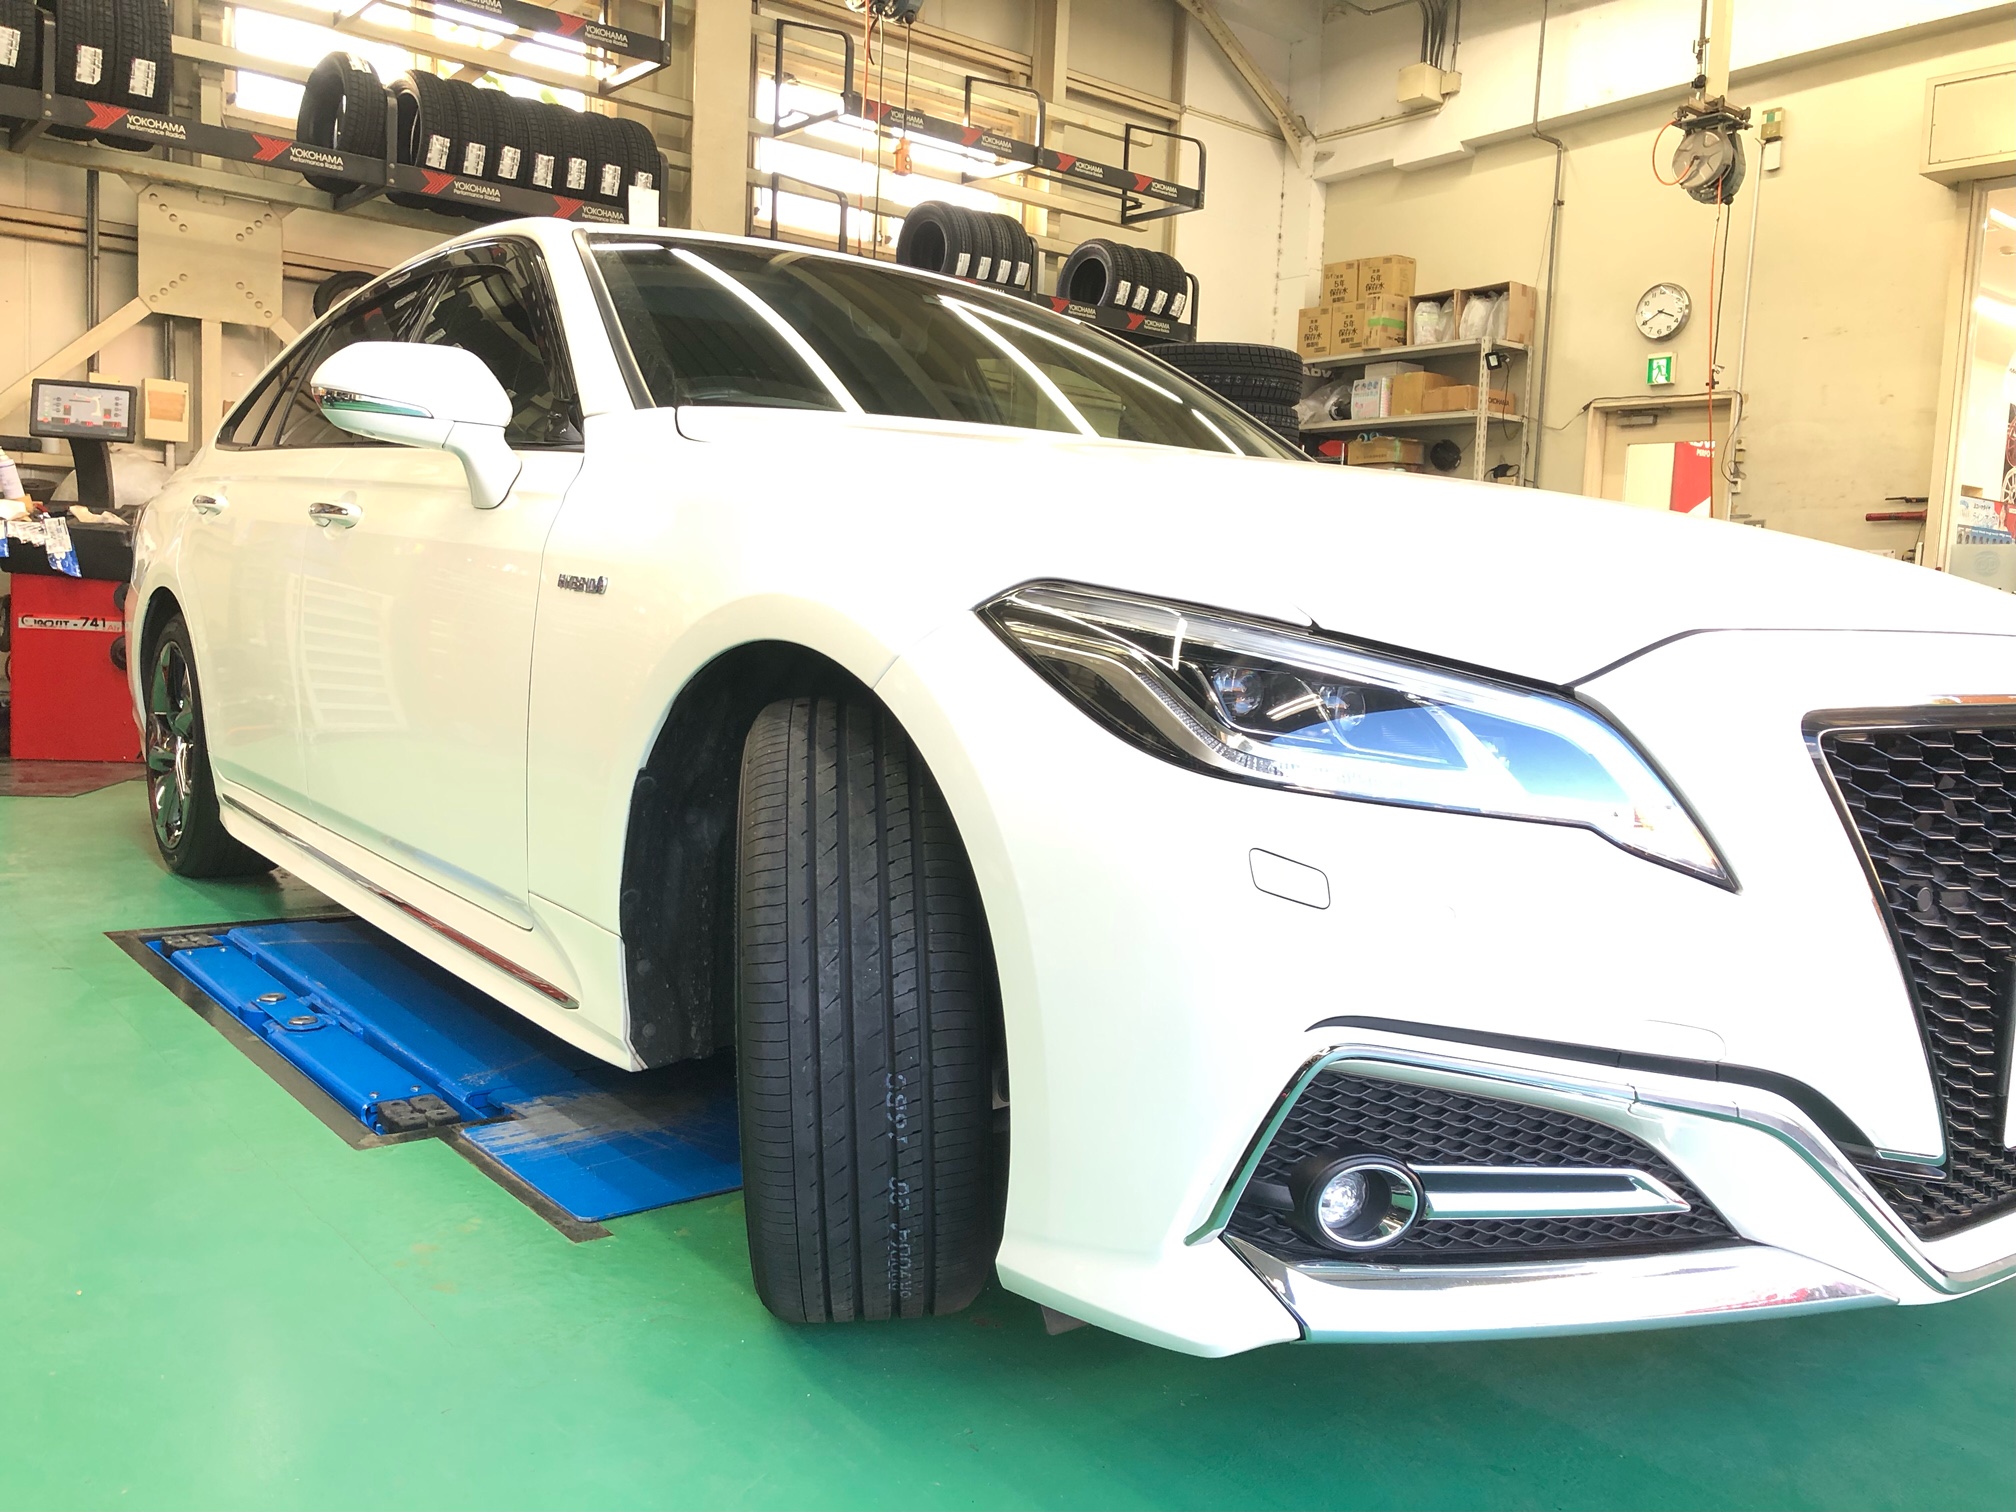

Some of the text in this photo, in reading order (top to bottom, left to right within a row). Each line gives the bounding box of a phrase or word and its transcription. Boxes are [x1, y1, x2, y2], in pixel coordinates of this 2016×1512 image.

[585, 25, 628, 42] YOKOHAMA
[127, 114, 186, 134] YOKOHAMA
[890, 110, 924, 125] YOKHAMA
[127, 123, 186, 140] Performance Radials
[982, 135, 1012, 149] YOKOHAMA
[290, 147, 343, 165] YOKOHAMA
[290, 155, 324, 167] Performance
[1075, 161, 1103, 174] YOKOHAMA
[454, 181, 501, 197] YOKOHAMA
[1151, 182, 1178, 194] YOKOHAMA
[582, 206, 624, 220] YOKOHAMA
[1068, 303, 1096, 315] YOKOHAMA
[1144, 319, 1170, 330] YOKOHAMA
